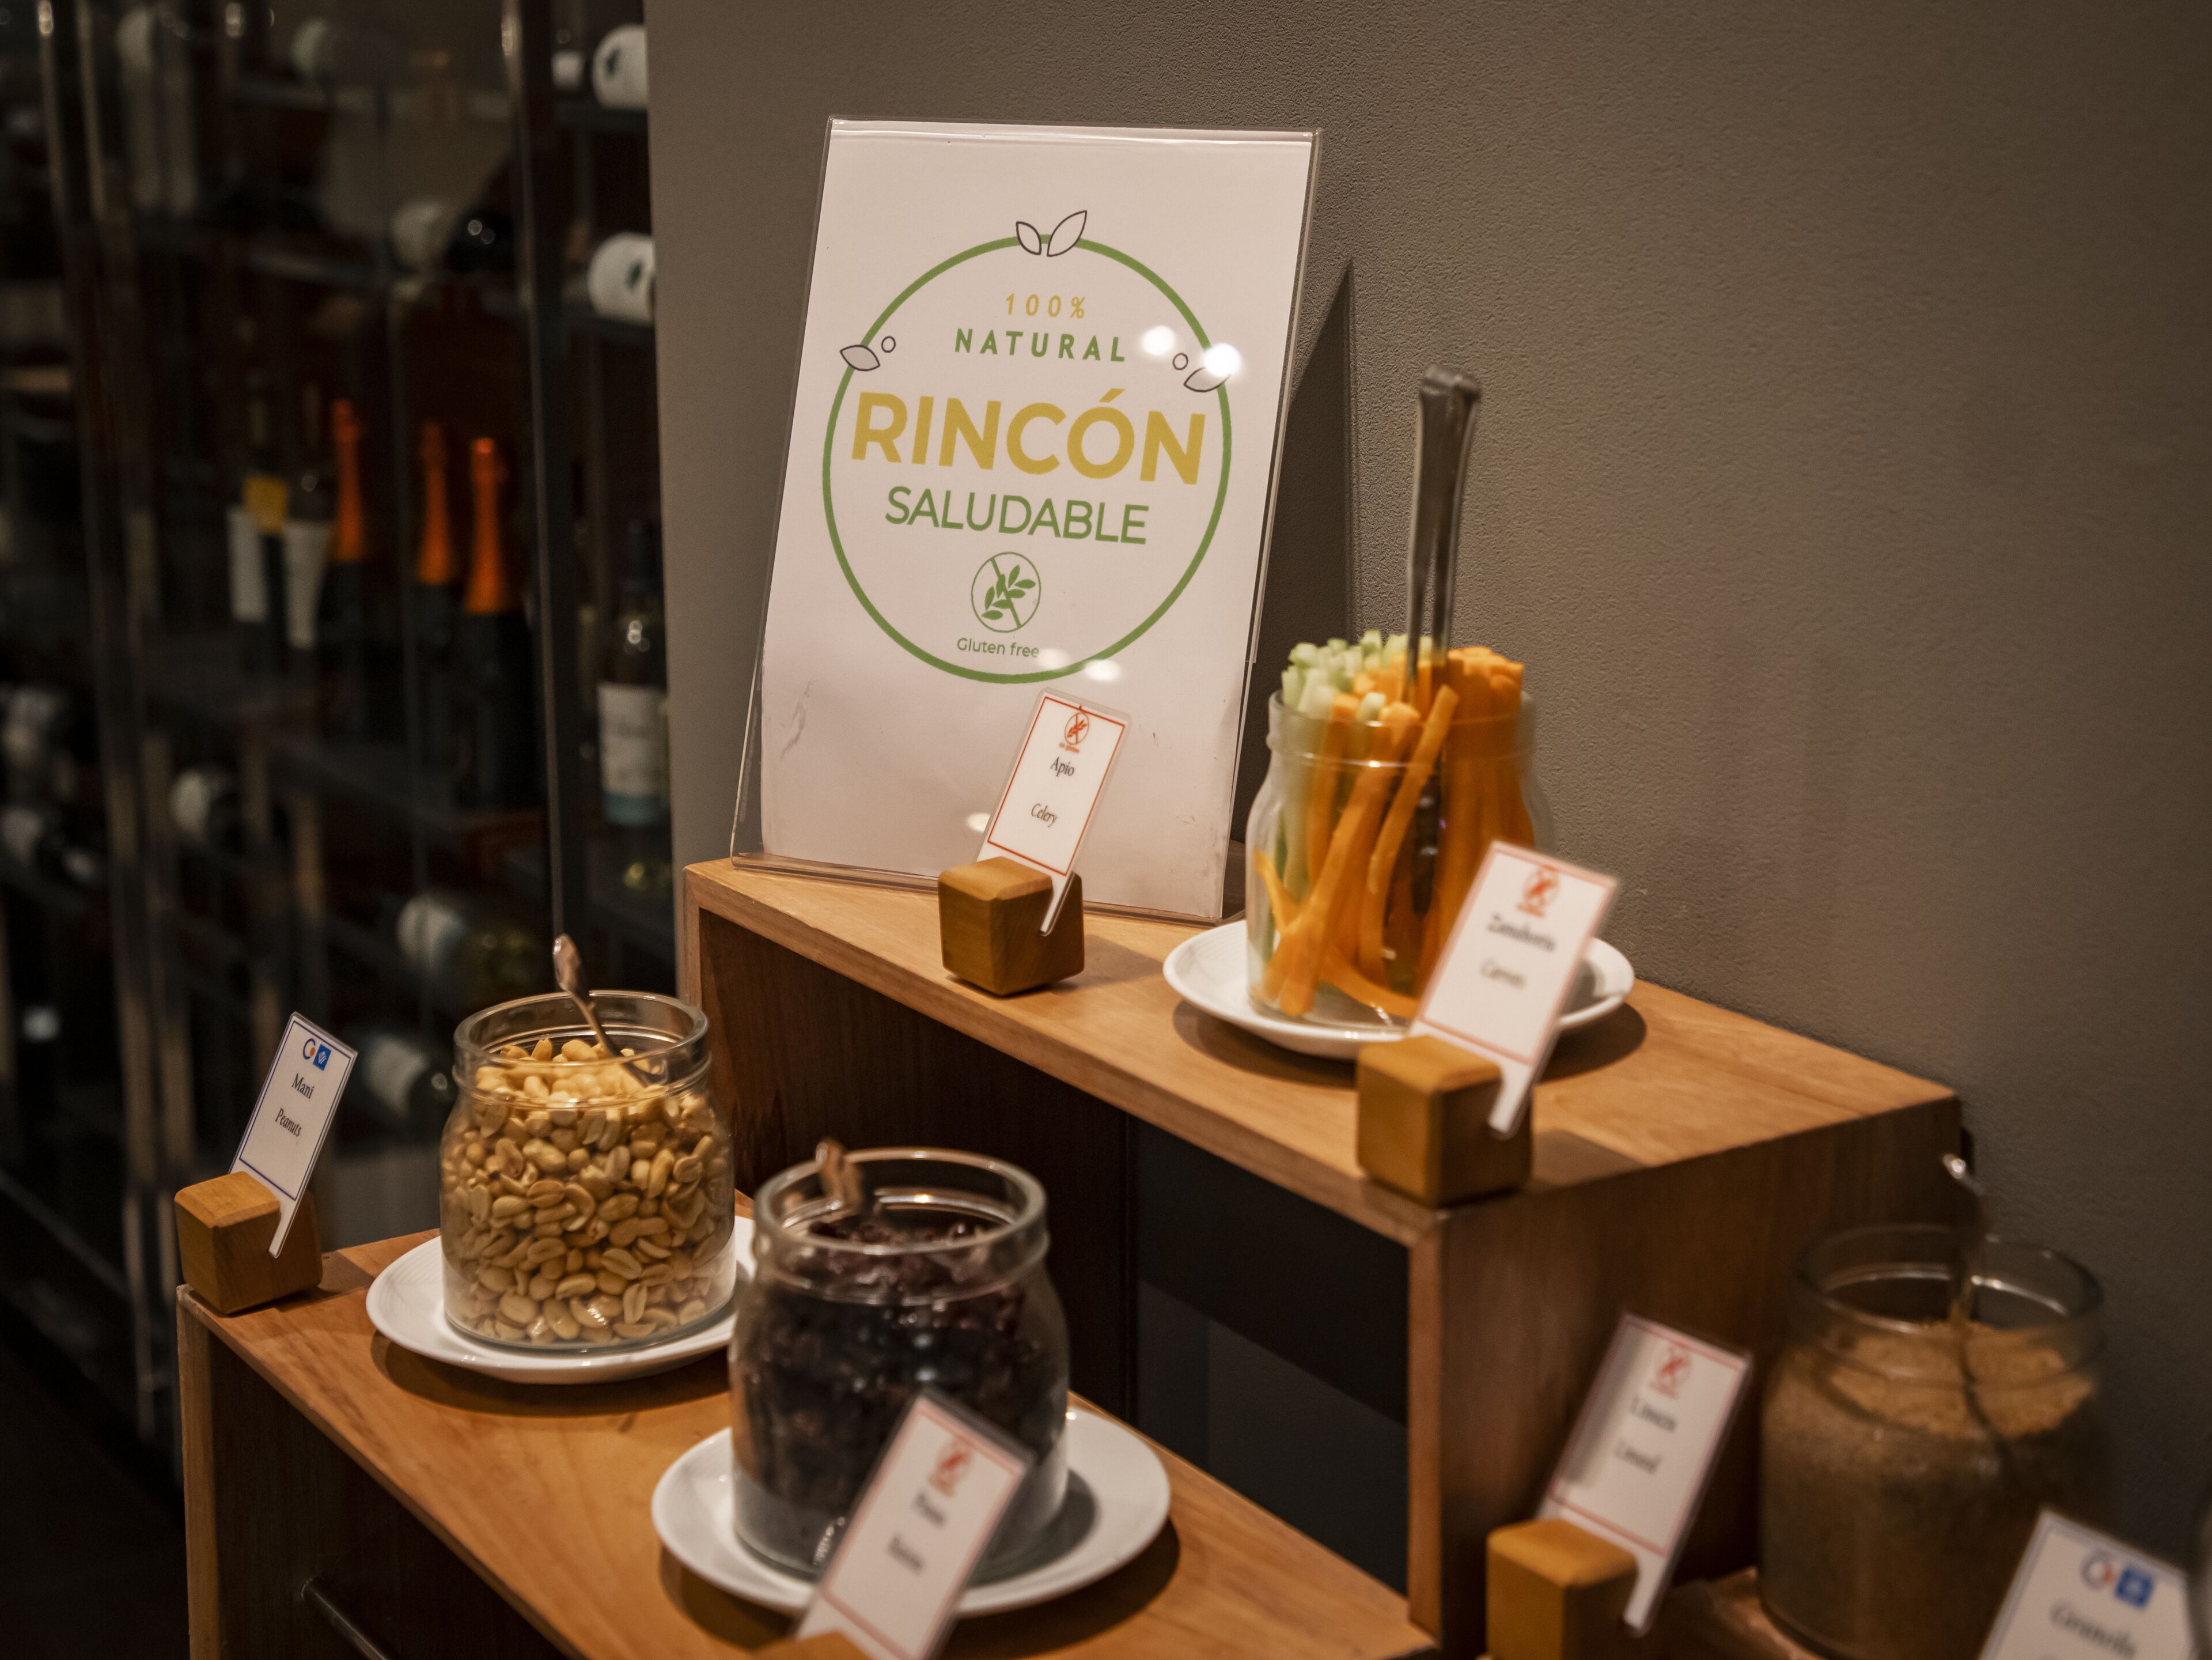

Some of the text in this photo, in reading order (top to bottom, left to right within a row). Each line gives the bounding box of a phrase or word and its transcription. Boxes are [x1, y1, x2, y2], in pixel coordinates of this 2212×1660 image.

[1006, 293, 1085, 319] 100%
[955, 328, 1124, 362] NATURAL
[851, 388, 1206, 485] RINCÓN
[885, 486, 1149, 544] SALUDABLE
[957, 637, 1039, 658] Gluten free
[1050, 757, 1075, 777] Apio
[1031, 803, 1058, 827] Celery
[291, 1073, 315, 1099] Maní
[275, 1107, 302, 1137] Peanuts
